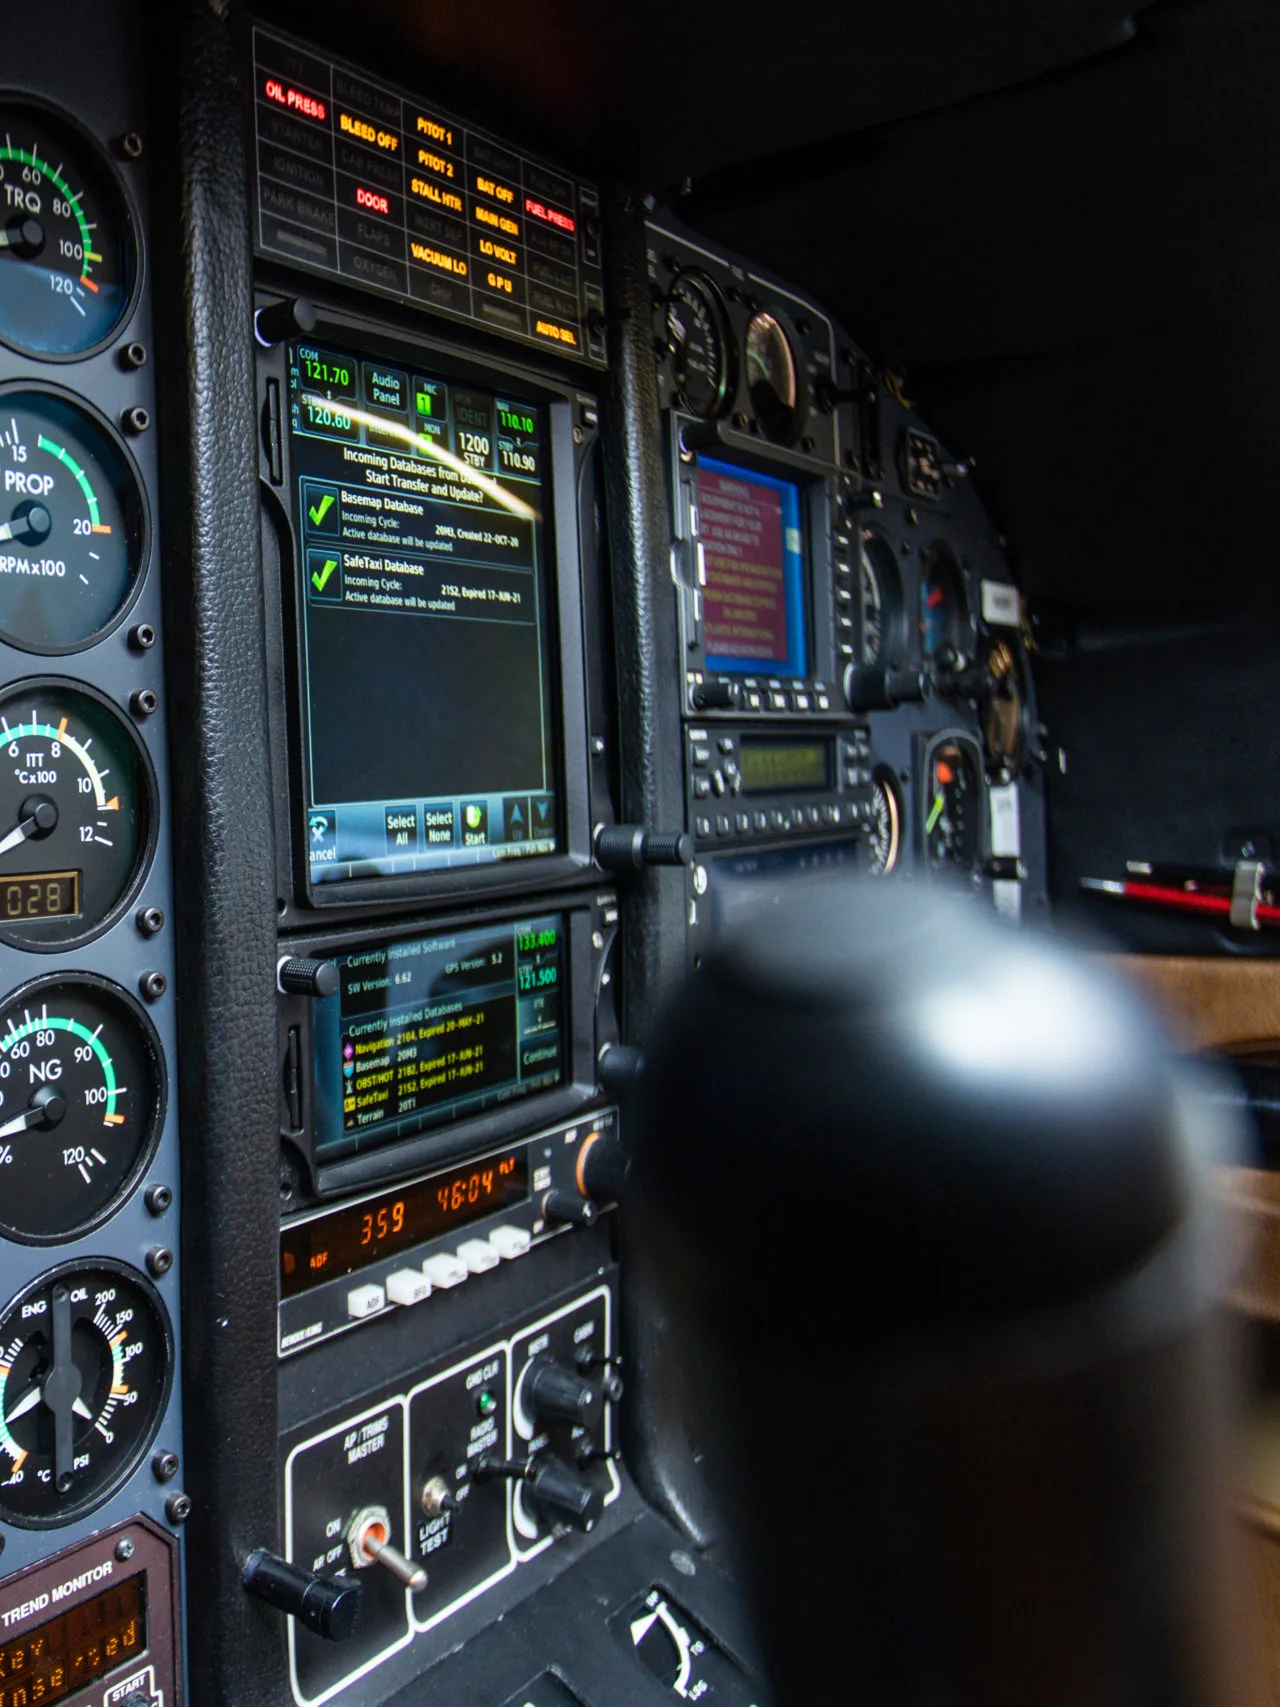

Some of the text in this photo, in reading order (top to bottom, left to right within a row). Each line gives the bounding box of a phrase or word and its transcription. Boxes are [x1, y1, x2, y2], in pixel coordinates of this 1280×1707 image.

[266, 79, 326, 120] OIL PRESS
[340, 113, 398, 151] BLEED OFF
[417, 116, 445, 142] PITOT
[418, 150, 446, 174] PITOT
[22, 168, 41, 185] 60
[4, 184, 41, 213] TRQ
[411, 178, 462, 213] STALL HTR
[477, 176, 514, 204] BAT OFF
[53, 200, 71, 218] 80
[356, 187, 388, 215] DOOR
[475, 206, 519, 236] MAIN GEN
[525, 198, 575, 232] FUEL PRESS
[59, 240, 82, 258] 100
[493, 243, 517, 265] VOLT
[411, 242, 467, 276] VACUUM LO
[50, 275, 73, 295] 120
[305, 361, 349, 386] 121.70
[372, 372, 400, 390] Audio
[373, 388, 400, 406] Panel
[308, 405, 351, 430] 120.60
[500, 412, 534, 434] 110.10
[459, 432, 489, 455] 1200
[12, 446, 27, 462] 15
[344, 447, 459, 480] Incoming Databases from
[464, 453, 486, 468] STBY
[502, 450, 536, 472] 110.90
[5, 470, 53, 495] PROP
[366, 469, 484, 504] Start Transfer and Update?
[341, 490, 424, 516] Basemap Database
[73, 519, 92, 534] 20
[342, 510, 376, 527] Incoming
[342, 527, 400, 544] Active database
[0, 556, 65, 576] RPMx100
[344, 554, 424, 576] SafeTaxi Database
[344, 574, 380, 590] Incoming
[345, 591, 402, 607] Active database
[8, 742, 18, 757] 6
[51, 742, 60, 757] 8
[26, 753, 44, 768] ITT
[77, 778, 91, 793] 10
[387, 814, 415, 830] Select
[426, 811, 452, 827] Select
[79, 826, 93, 842] 12
[396, 832, 408, 846] All
[428, 828, 451, 843] None
[465, 832, 485, 847] Start
[7, 883, 62, 916] 028
[347, 951, 386, 968] Currently
[348, 1001, 463, 1037] Currently Databases
[36, 1030, 55, 1046] 80
[355, 1038, 394, 1055] Navigation
[11, 1042, 29, 1058] 60
[75, 1046, 92, 1063] 90
[29, 1060, 63, 1083] NG
[356, 1056, 390, 1073] Basemap
[85, 1087, 107, 1104] 100
[357, 1109, 384, 1125] Terrain
[63, 1146, 84, 1165] 120
[360, 1200, 406, 1246] 359
[437, 1169, 494, 1213] 46:04
[309, 1251, 329, 1270] ADF
[70, 1288, 88, 1302] OIL
[95, 1290, 115, 1305] 200
[22, 1301, 47, 1319] ENG
[116, 1309, 133, 1324] 150
[125, 1342, 143, 1358] 100
[122, 1392, 138, 1406] 50
[105, 1432, 113, 1443] 0
[470, 1416, 495, 1442] RADIO
[347, 1433, 385, 1465] MASTER
[467, 1428, 499, 1459] MASTER
[74, 1454, 89, 1470] PSI
[455, 1463, 467, 1480] ON
[455, 1483, 470, 1502] OFF
[326, 1517, 342, 1538] ON
[420, 1510, 451, 1540] LIGHT
[420, 1527, 449, 1556] TEST
[326, 1544, 343, 1564] OFF
[2, 1593, 50, 1629] TREND
[51, 1561, 113, 1602] MONITOR
[113, 1674, 146, 1702] START
